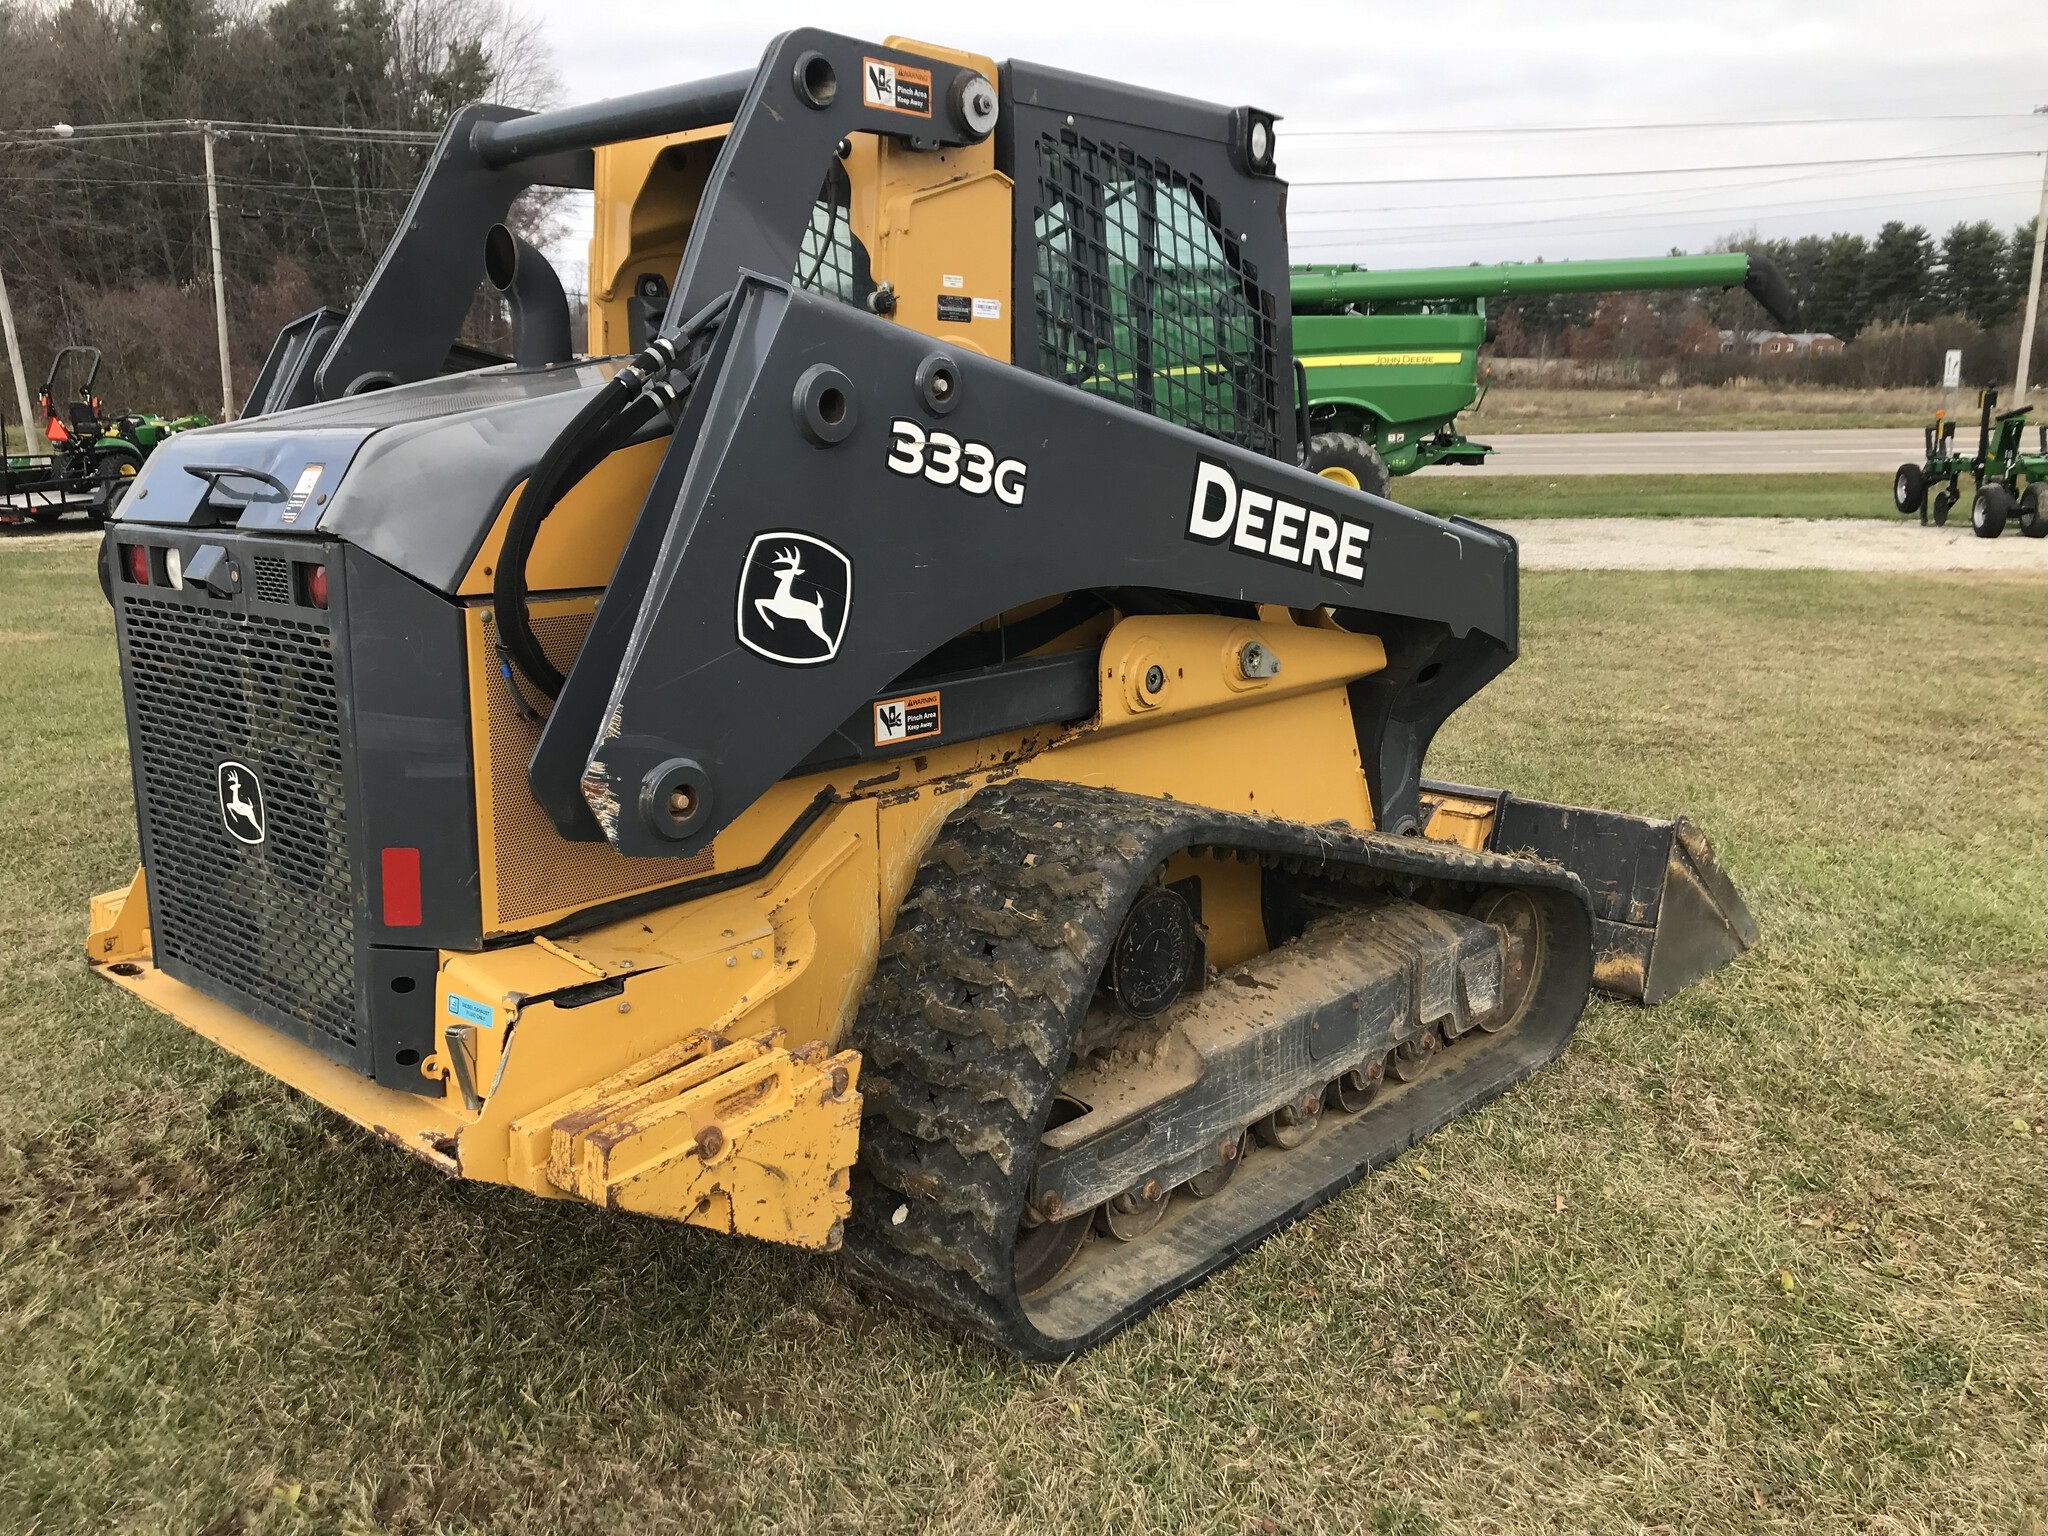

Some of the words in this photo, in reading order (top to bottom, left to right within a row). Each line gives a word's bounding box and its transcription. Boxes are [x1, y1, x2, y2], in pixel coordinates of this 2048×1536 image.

[897, 85, 914, 96] Pinch
[914, 89, 927, 98] Area
[897, 96, 910, 105] Keep
[910, 98, 923, 108] Away
[1375, 356, 1400, 364] JOHN
[1402, 355, 1434, 363] DEERE
[888, 421, 1027, 505] 333G
[1189, 461, 1370, 580] DEERE
[912, 696, 937, 705] WARNING
[907, 714, 923, 722] Pinch
